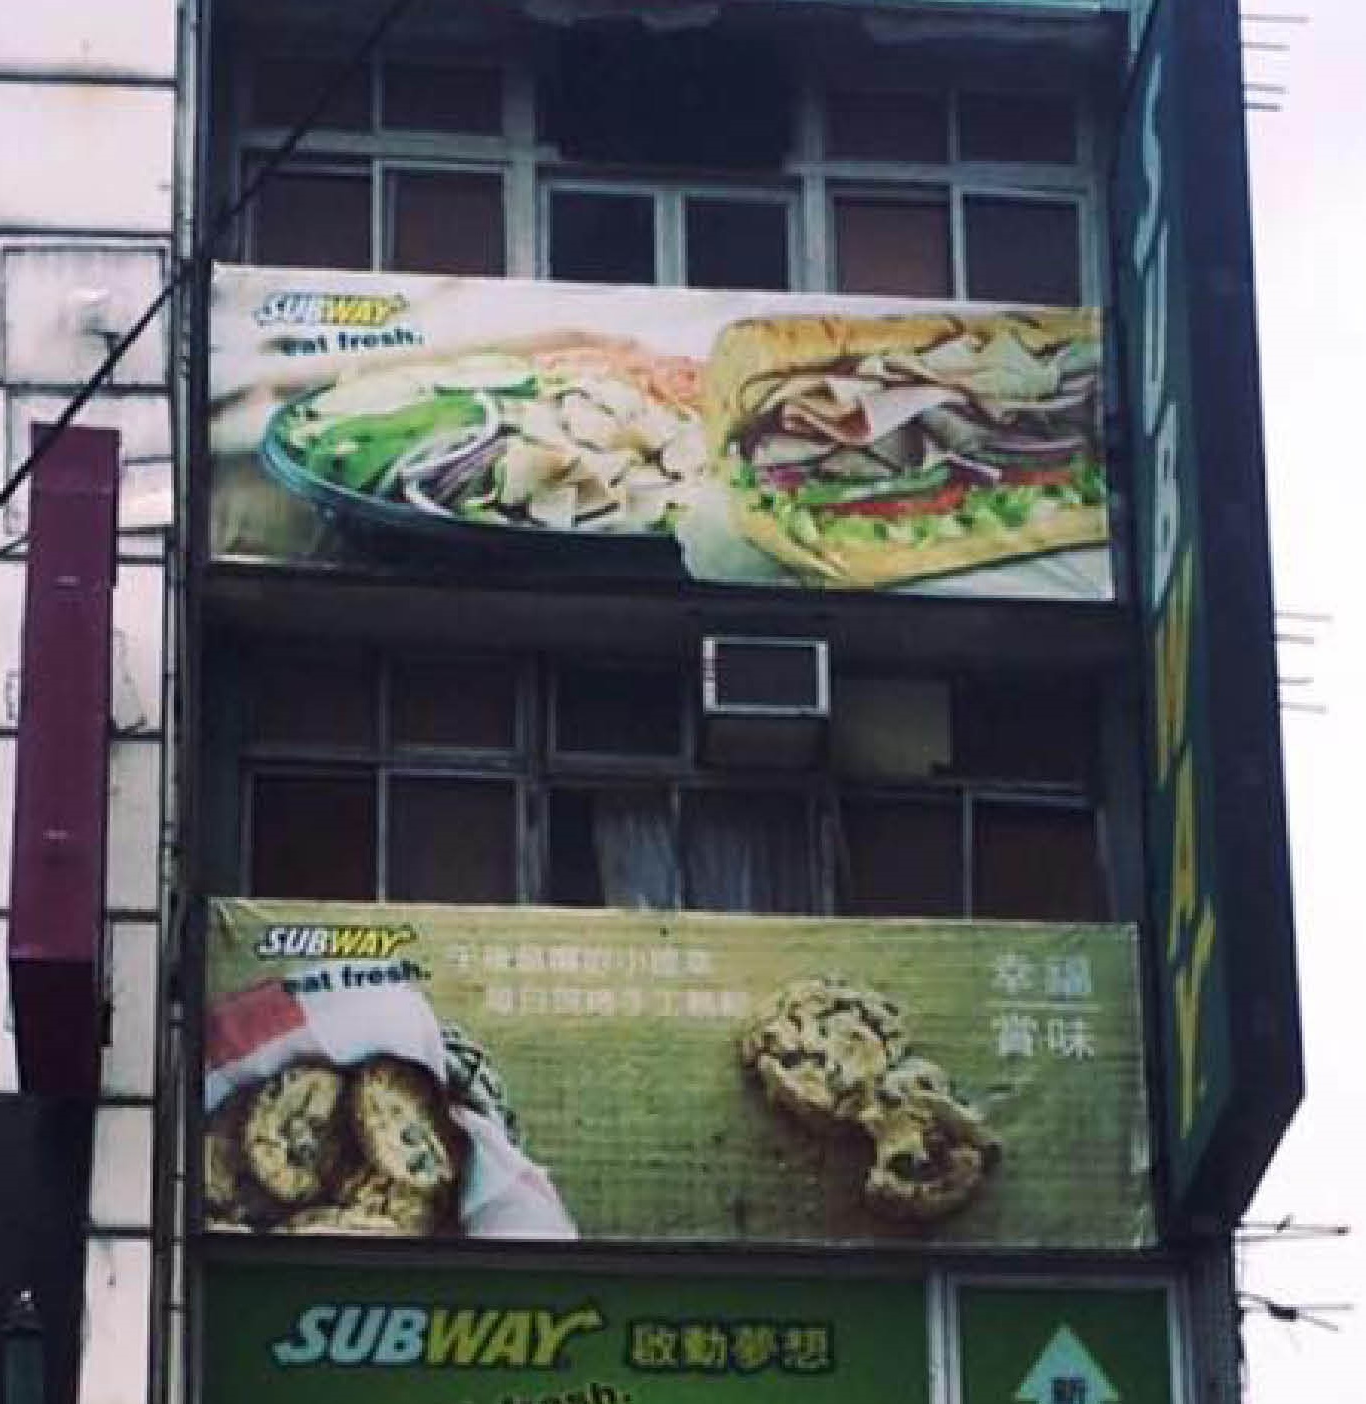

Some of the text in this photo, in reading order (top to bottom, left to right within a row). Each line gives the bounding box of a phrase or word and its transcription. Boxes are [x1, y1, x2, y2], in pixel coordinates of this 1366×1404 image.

[251, 292, 410, 327] SUBWAY
[253, 922, 419, 960] SUBWAY
[271, 1304, 604, 1367] SUBWAY
